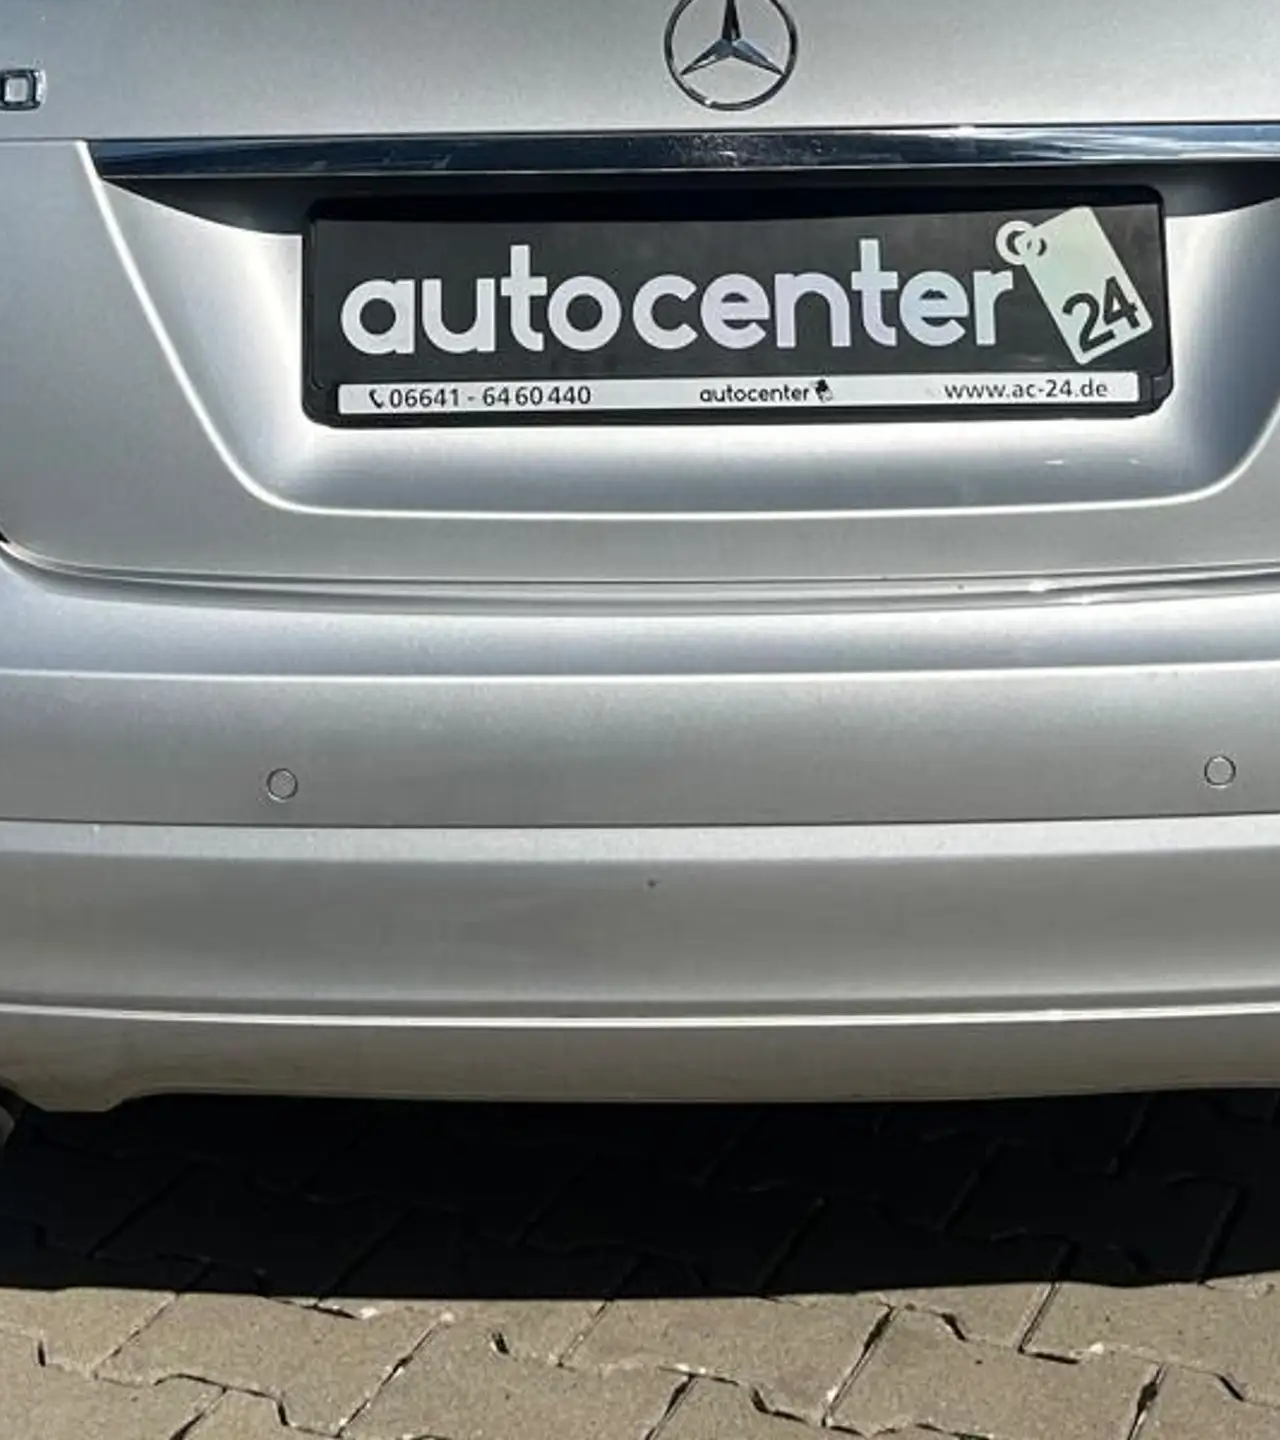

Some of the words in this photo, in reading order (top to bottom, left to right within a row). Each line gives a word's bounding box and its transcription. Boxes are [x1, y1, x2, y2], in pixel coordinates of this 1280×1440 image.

[1060, 276, 1141, 349] 24
[389, 388, 461, 408] 06641
[699, 384, 810, 403] autocenter
[942, 380, 1109, 401] www.ac-24.de
